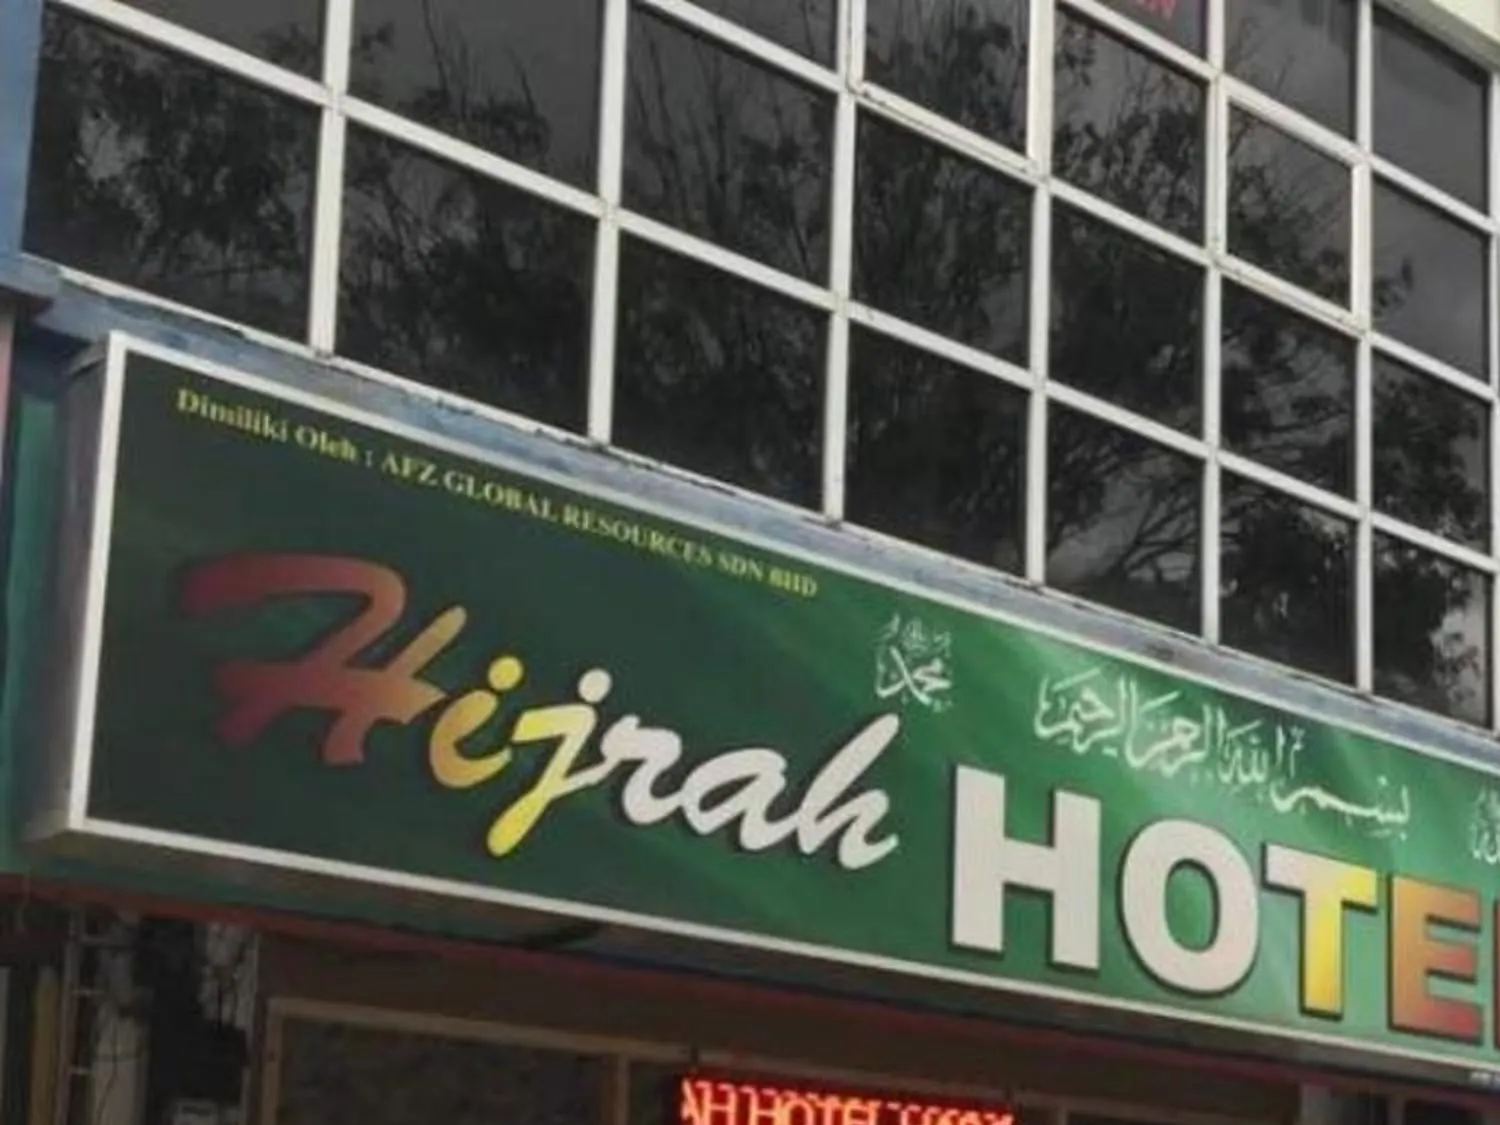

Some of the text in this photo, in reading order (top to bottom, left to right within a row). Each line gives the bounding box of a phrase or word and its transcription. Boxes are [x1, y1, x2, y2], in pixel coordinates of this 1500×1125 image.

[177, 388, 289, 443] Dimiliki
[294, 424, 358, 461] Oleh
[381, 451, 438, 486] AFZ
[443, 469, 556, 523] GLOBAL
[562, 503, 713, 566] RESOURCES
[717, 551, 764, 582] SDN
[768, 567, 819, 598] BHD
[178, 552, 900, 869] Hijrah
